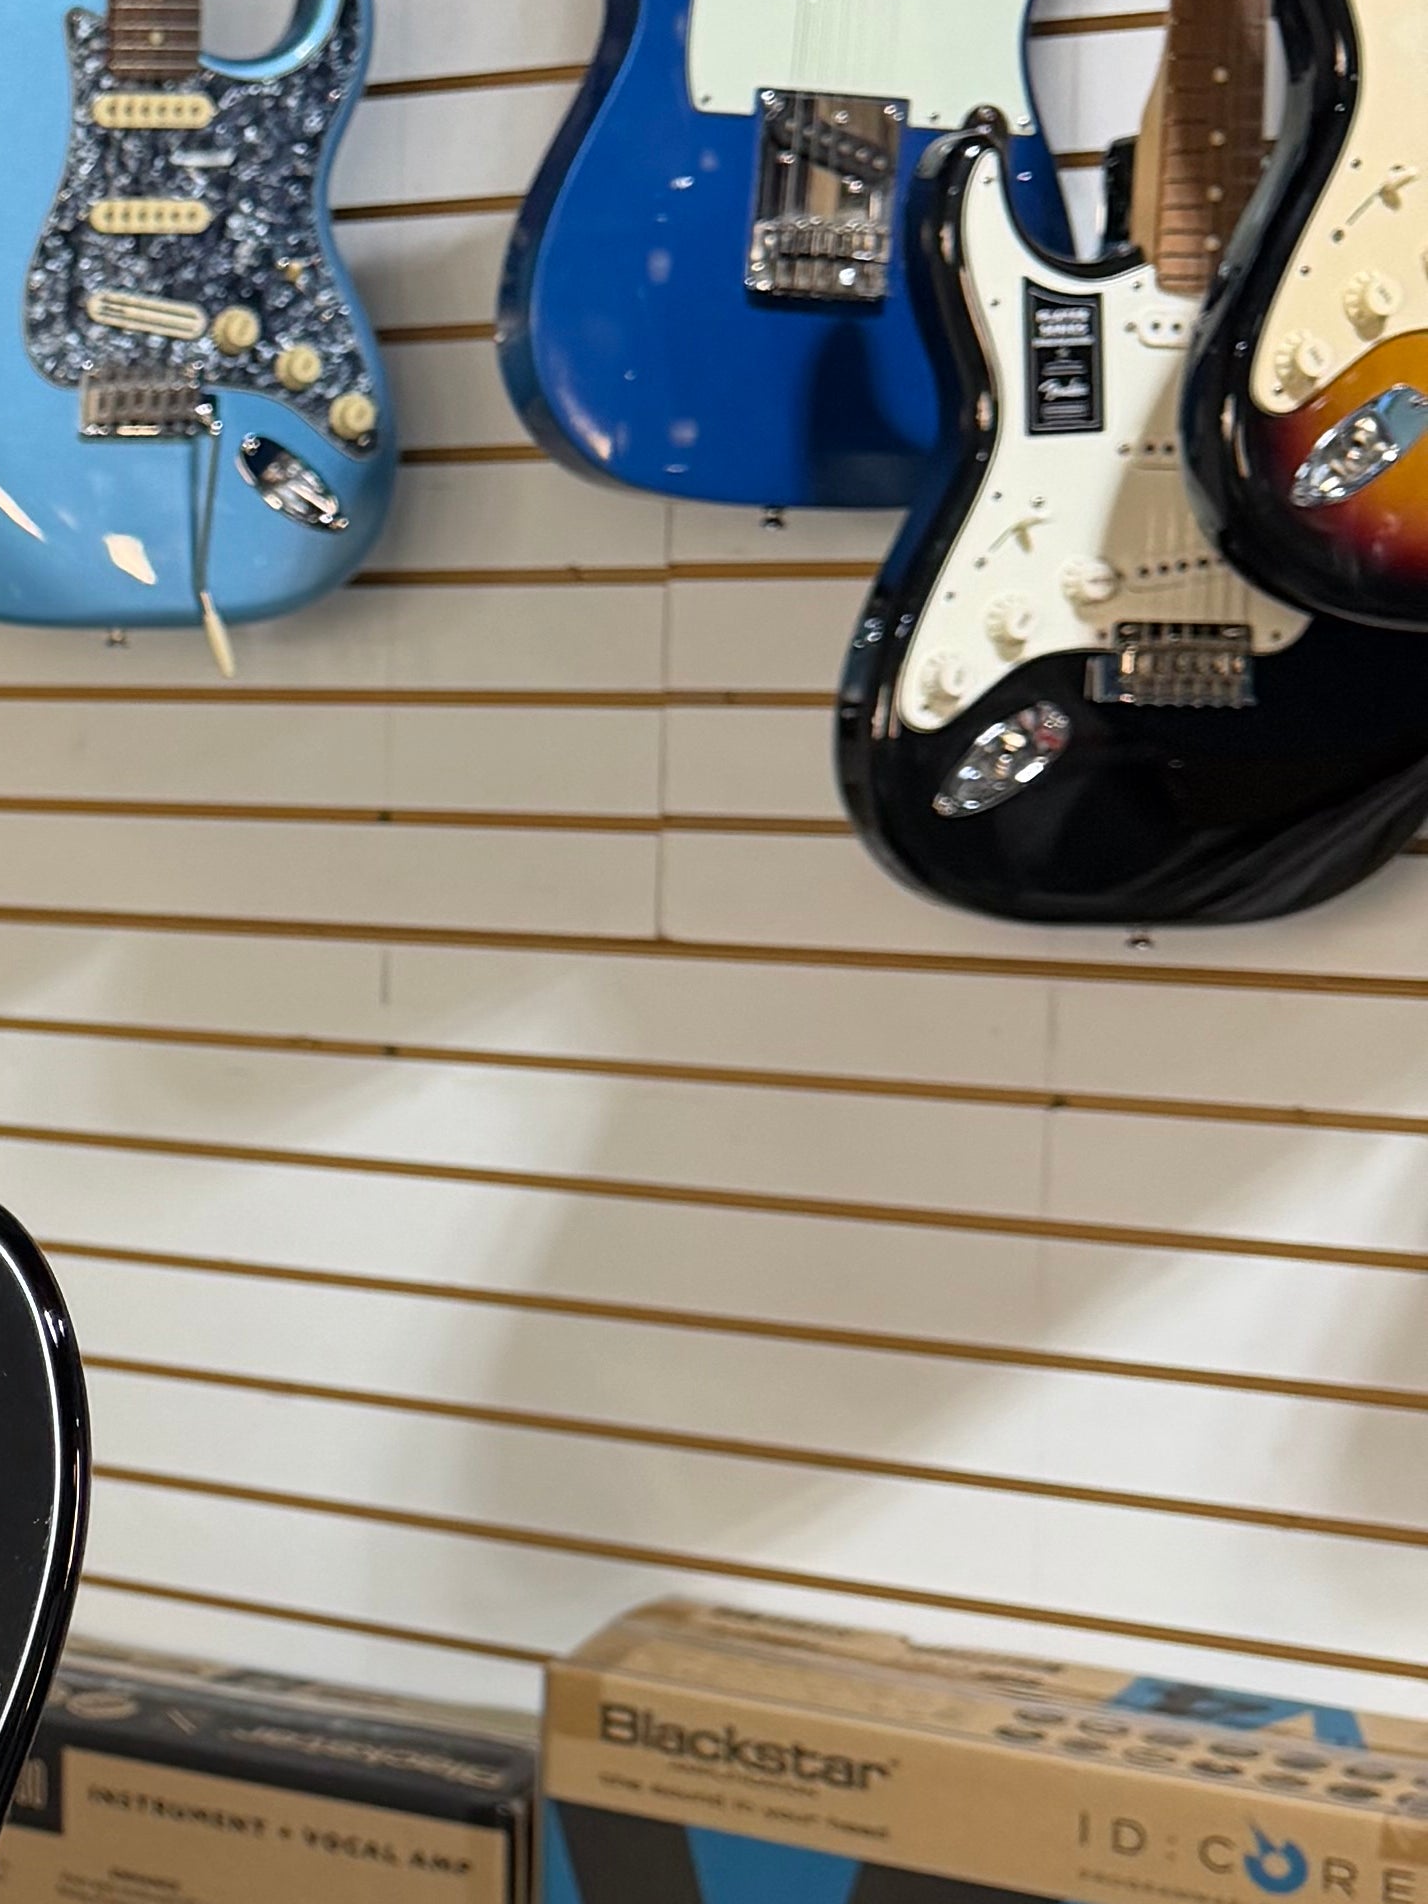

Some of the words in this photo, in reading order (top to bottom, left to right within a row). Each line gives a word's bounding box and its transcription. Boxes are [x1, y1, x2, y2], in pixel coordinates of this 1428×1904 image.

[598, 1701, 890, 1790] Blackstar
[88, 1785, 266, 1838] INSTRUMENT
[301, 1825, 400, 1866] VOCAL
[408, 1848, 472, 1876] AMP
